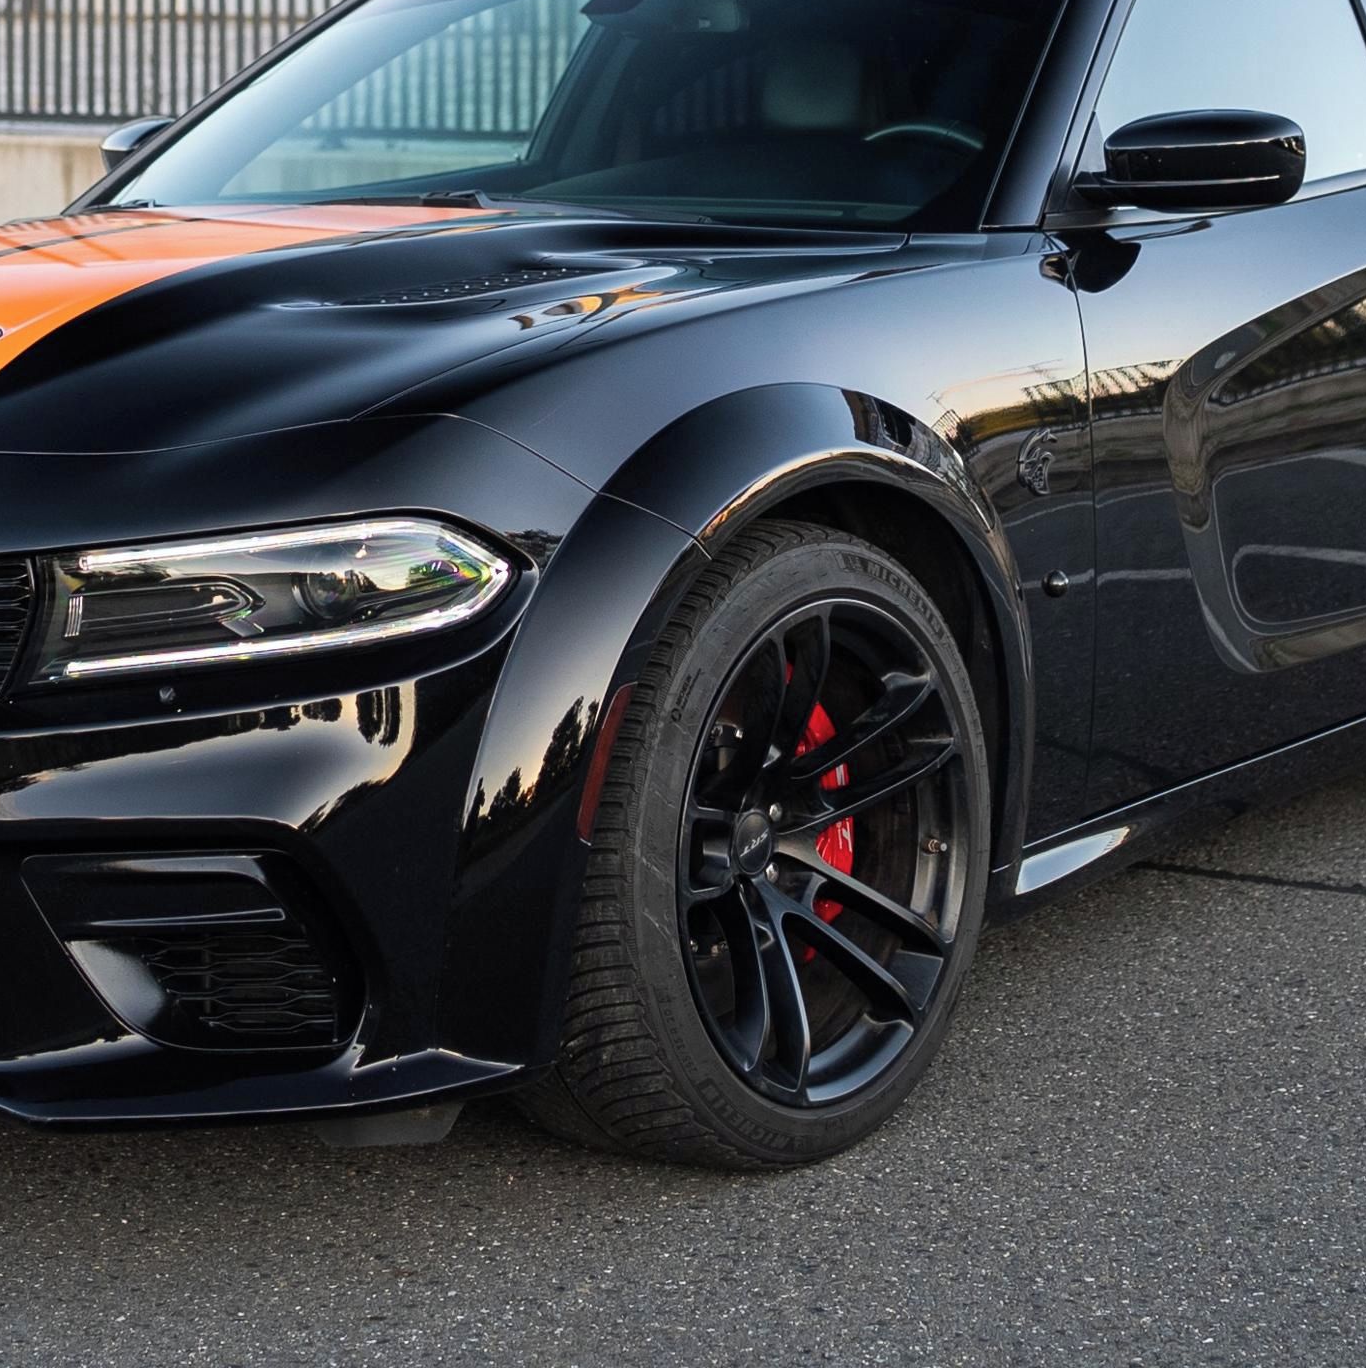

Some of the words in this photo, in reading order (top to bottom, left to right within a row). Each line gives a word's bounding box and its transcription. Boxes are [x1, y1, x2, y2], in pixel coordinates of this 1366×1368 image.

[866, 559, 943, 634] MICHELIN
[739, 827, 770, 858] SRT
[700, 1083, 790, 1150] MICHELIN
